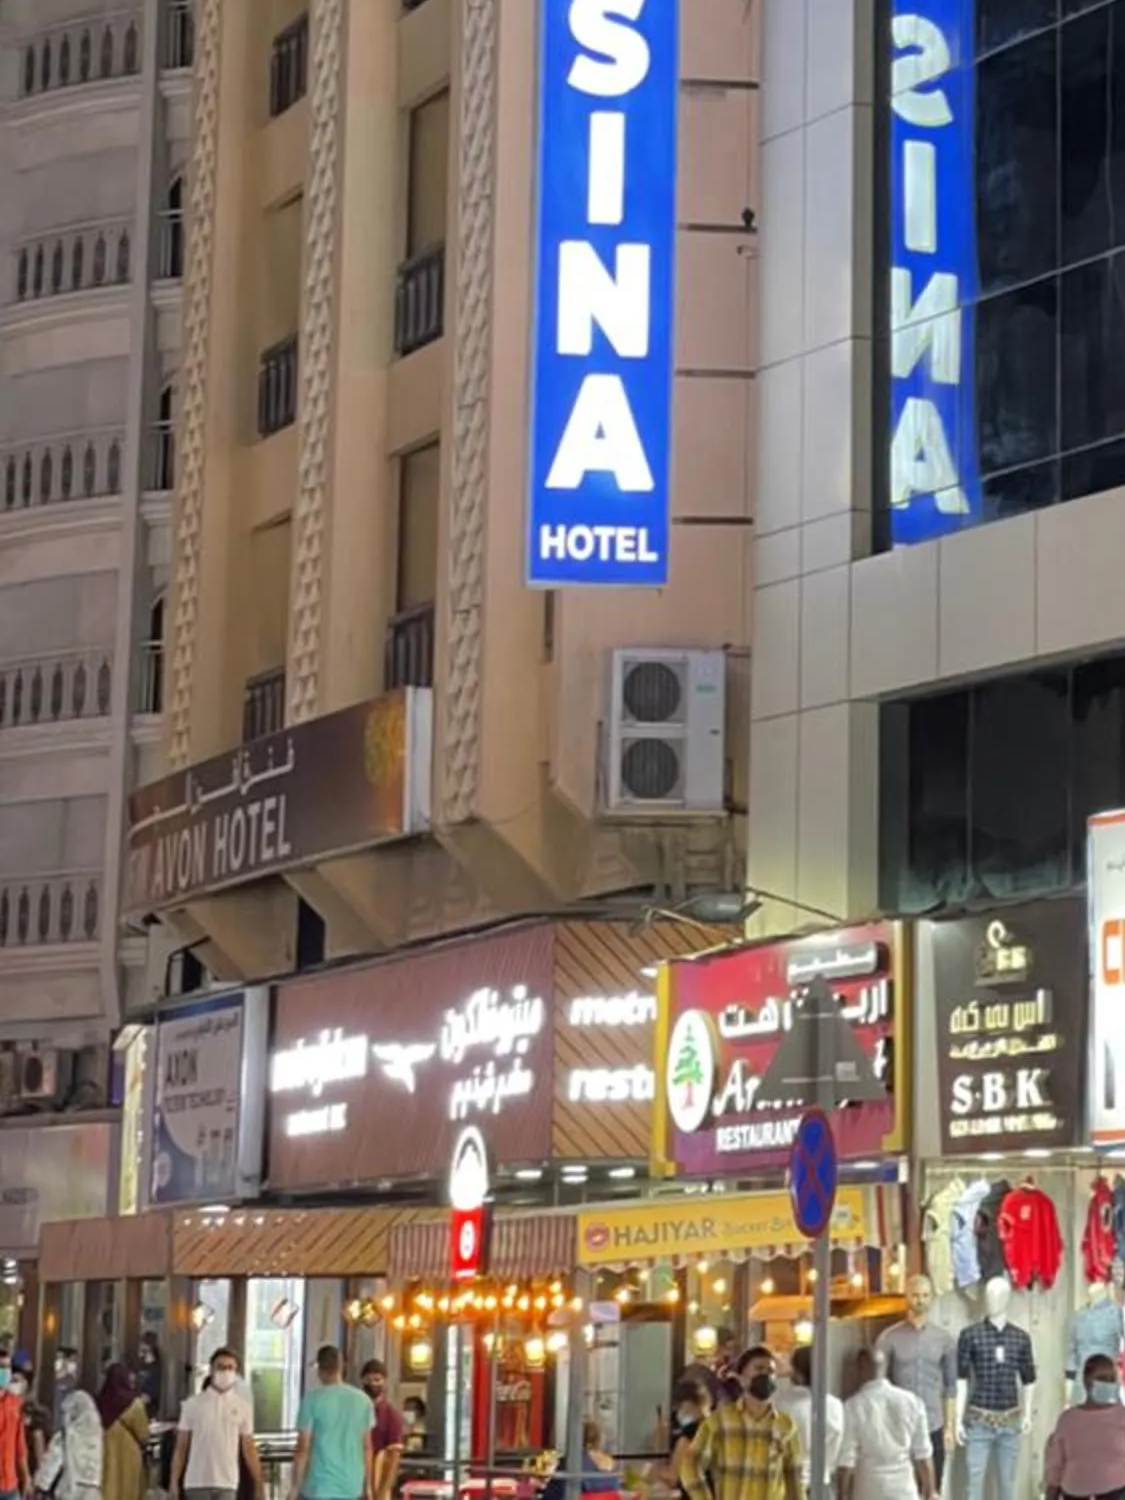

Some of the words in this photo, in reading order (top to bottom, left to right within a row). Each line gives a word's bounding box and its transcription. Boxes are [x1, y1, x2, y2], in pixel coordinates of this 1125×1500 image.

[540, 524, 658, 563] HOTEL
[213, 794, 291, 878] HOTEL
[613, 1217, 718, 1249] HAJIYAR
